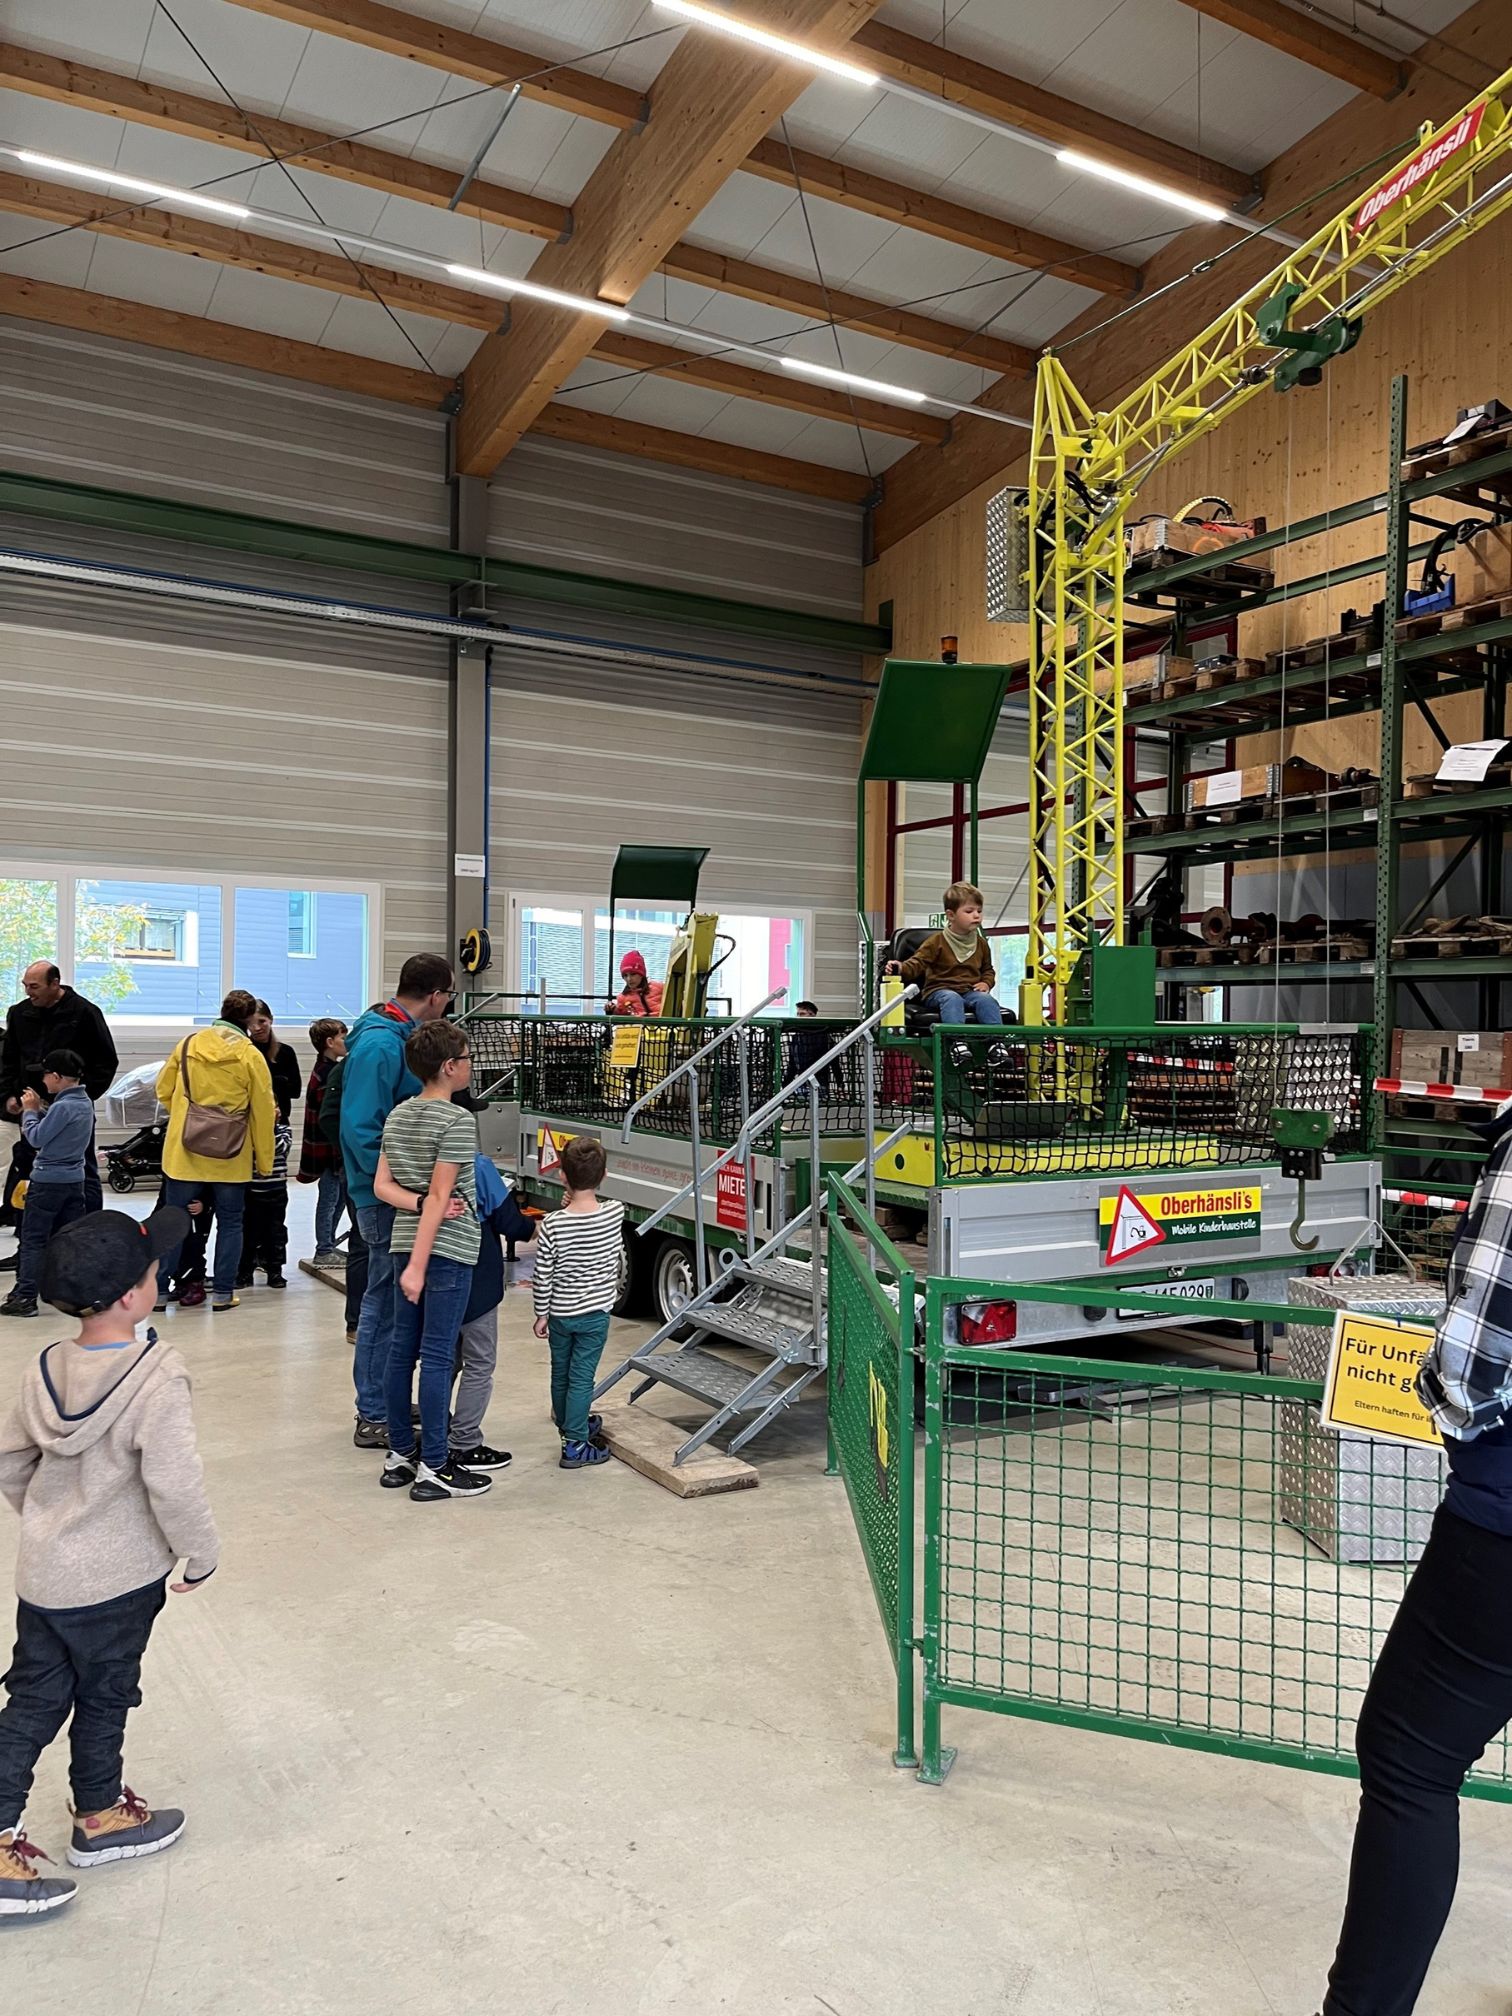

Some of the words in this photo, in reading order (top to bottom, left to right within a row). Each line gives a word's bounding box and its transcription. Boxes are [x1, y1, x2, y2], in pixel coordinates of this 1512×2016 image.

[1357, 115, 1473, 226] Oberhänsli
[1161, 1191, 1252, 1216] Oberhänsli's
[1171, 1223, 1197, 1235] Mobile
[1198, 1218, 1257, 1233] Kinderbaustelle
[1345, 1337, 1377, 1355] Für
[1347, 1365, 1397, 1386] nicht
[1354, 1400, 1380, 1412] Eltern
[1381, 1406, 1410, 1418] haften
[1411, 1412, 1425, 1421] für
